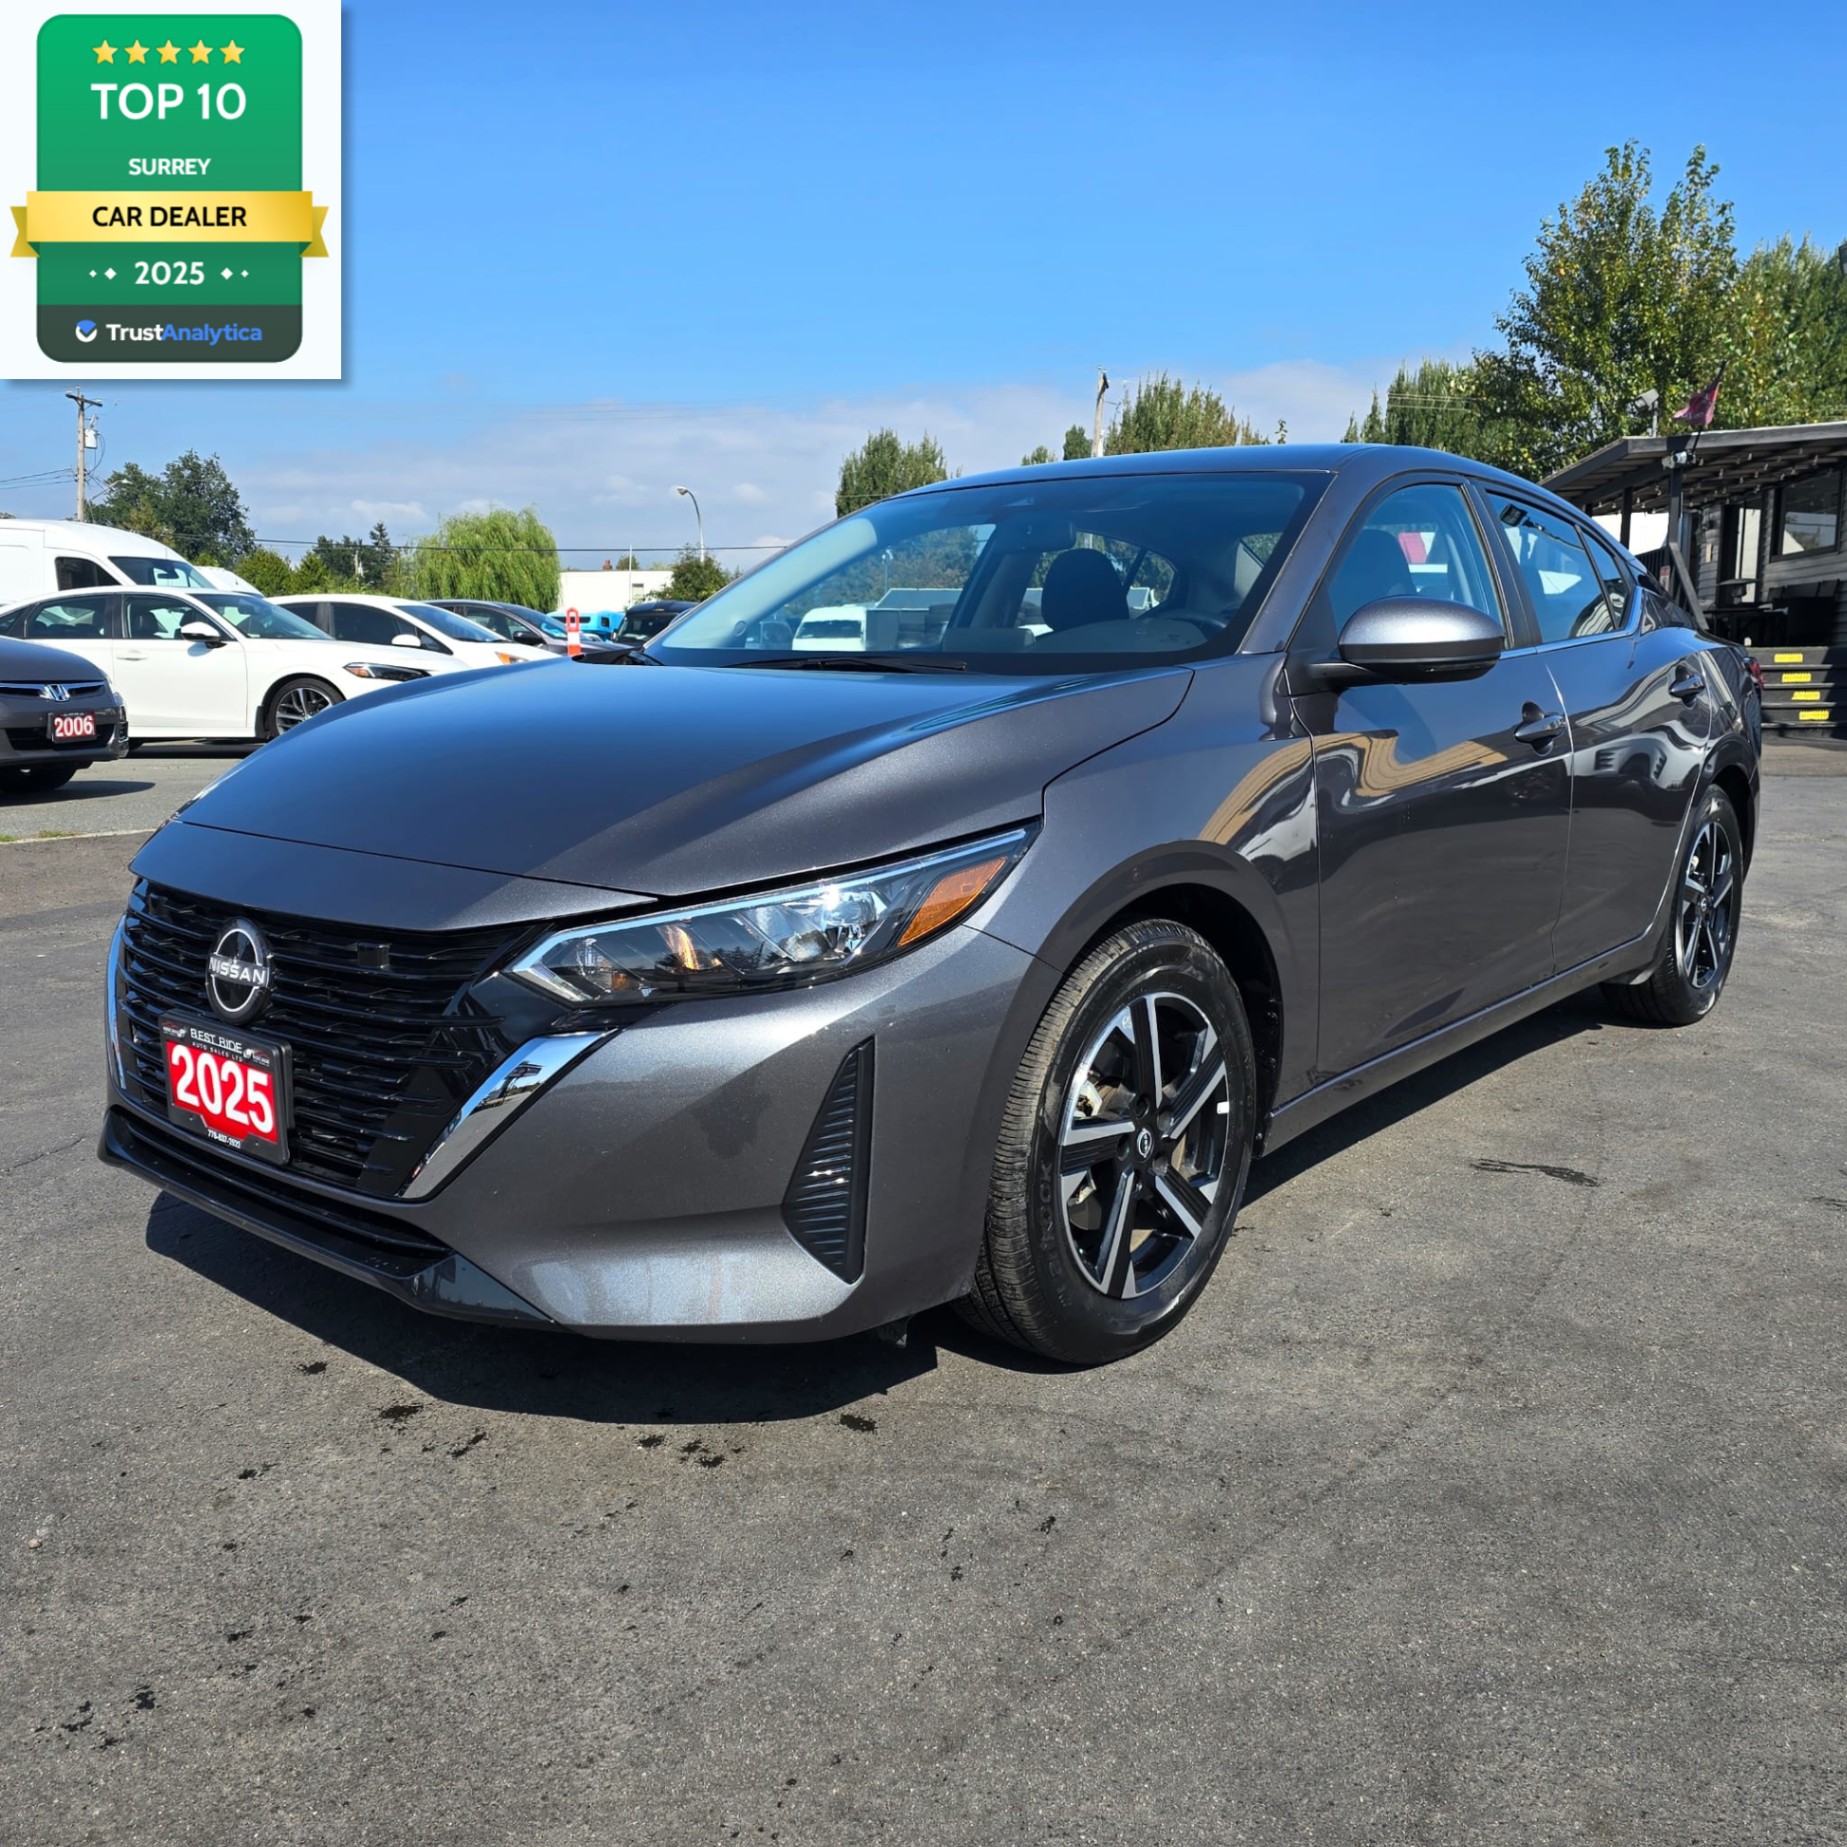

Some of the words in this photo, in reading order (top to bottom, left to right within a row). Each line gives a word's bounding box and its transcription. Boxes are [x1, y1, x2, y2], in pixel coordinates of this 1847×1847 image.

[54, 715, 94, 737] 2006
[209, 957, 266, 984] NISSAN
[190, 1028, 215, 1043] BEST
[219, 1037, 243, 1053] RIDE
[171, 1044, 273, 1134] 2025
